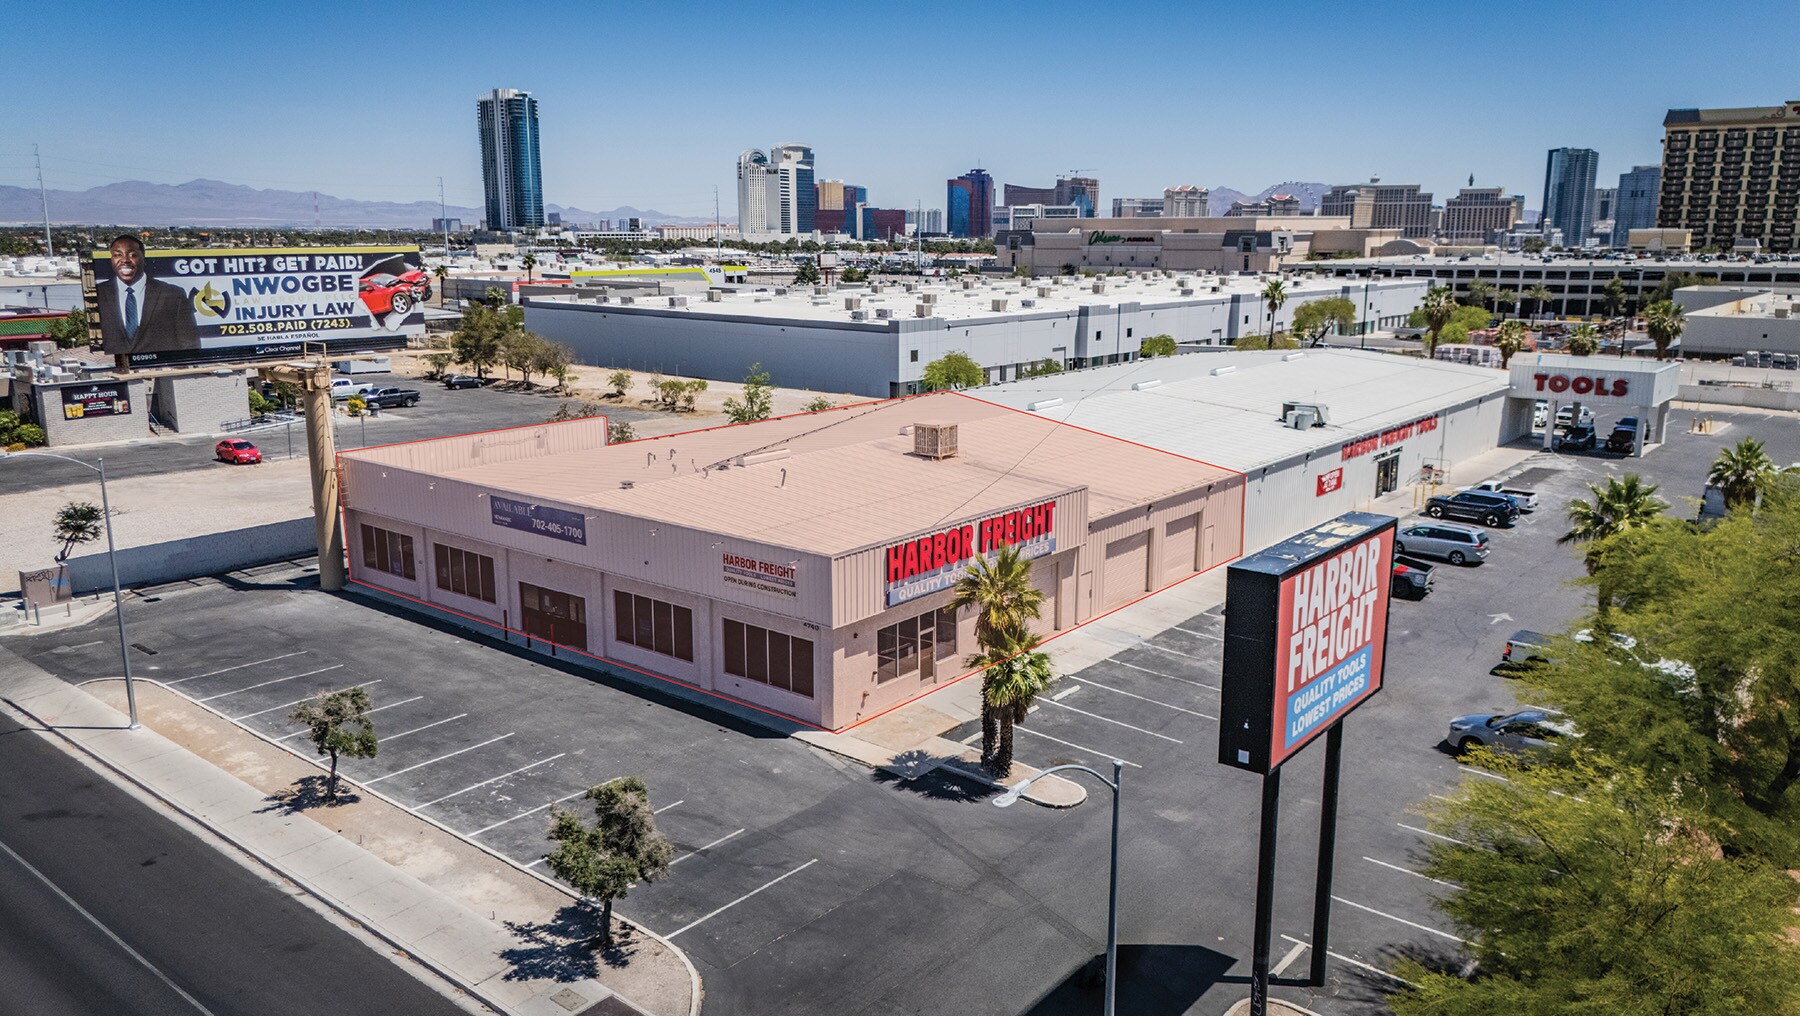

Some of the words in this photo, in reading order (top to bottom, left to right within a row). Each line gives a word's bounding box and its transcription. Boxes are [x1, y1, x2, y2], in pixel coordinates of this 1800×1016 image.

[174, 258, 218, 274] GOT
[224, 257, 266, 273] HIT?
[272, 256, 310, 272] GET
[314, 255, 364, 271] PAID!
[232, 275, 353, 296] NWOGBE
[235, 304, 307, 321] INJURY
[313, 302, 354, 316] LAW
[220, 320, 307, 335] 702.508.PAID
[1534, 374, 1629, 397] TOOLS
[494, 501, 532, 517] AVAILABLE
[532, 518, 582, 538] 702-405-1700
[886, 525, 974, 583] HARBOR
[980, 501, 1056, 554] FREIGHT
[723, 554, 756, 571] HARBOR
[759, 562, 795, 579] FREIGHT
[738, 579, 756, 588] DURING
[757, 584, 796, 597] CONSTRUCTION
[899, 577, 942, 600] QUALITY
[1292, 537, 1380, 634] HARBOR
[803, 622, 820, 631] 4740
[1288, 588, 1378, 692] FREIGHT
[1293, 674, 1335, 714] QUALITY
[1337, 653, 1366, 687] TOOLS
[1292, 698, 1331, 738] LOWEST
[1332, 673, 1365, 708] PRICES
